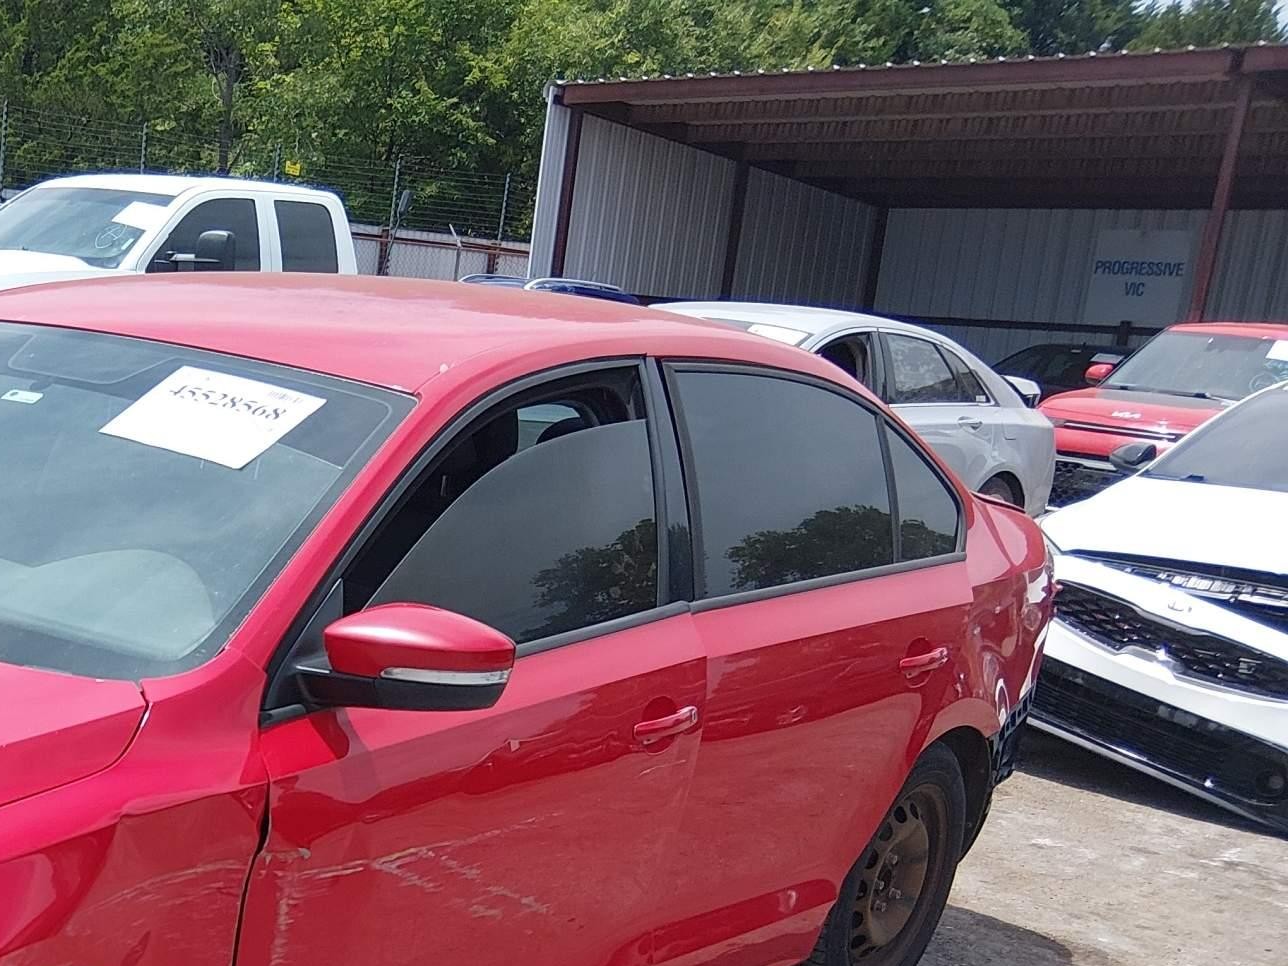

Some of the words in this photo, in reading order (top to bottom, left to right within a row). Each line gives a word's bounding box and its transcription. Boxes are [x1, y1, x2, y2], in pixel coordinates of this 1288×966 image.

[1093, 260, 1186, 277] PROGRESSIVE
[1124, 281, 1145, 297] VIC
[168, 384, 288, 421] 45528568
